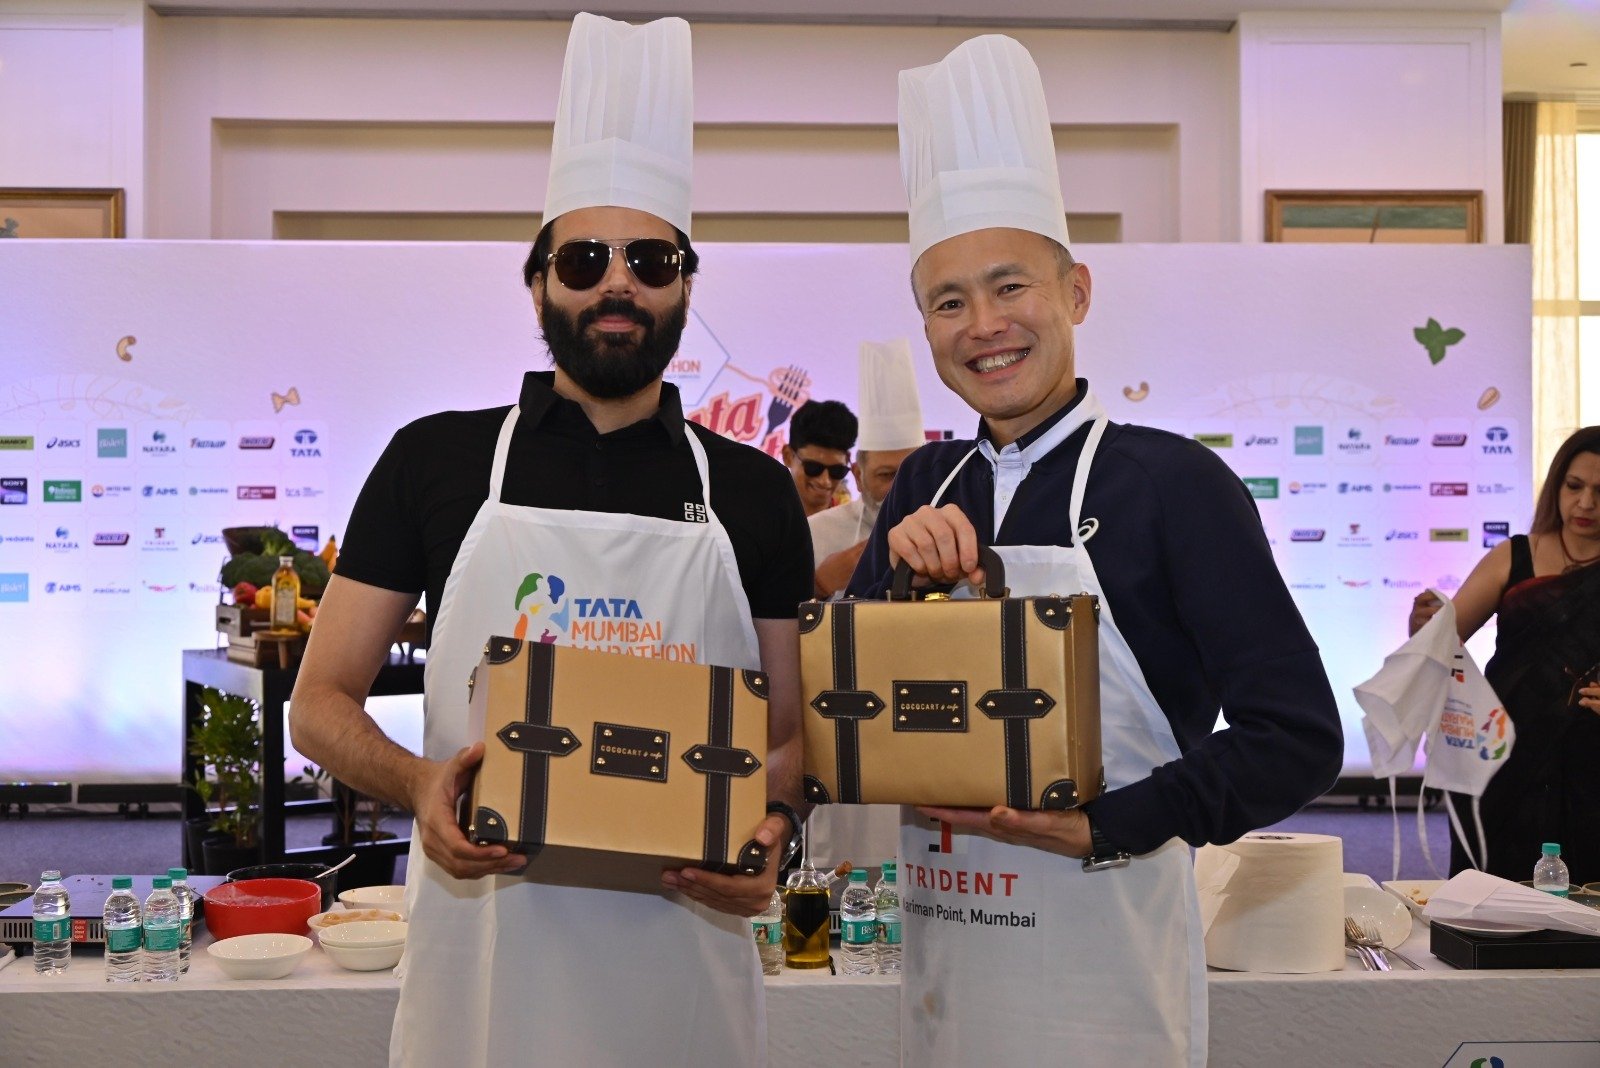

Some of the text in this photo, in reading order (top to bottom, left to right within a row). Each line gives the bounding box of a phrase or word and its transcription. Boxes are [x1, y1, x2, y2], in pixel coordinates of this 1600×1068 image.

[290, 448, 322, 457] TATA
[1481, 445, 1513, 454] TATA
[574, 598, 643, 619] TATA
[571, 620, 663, 642] MUMBAI
[901, 703, 940, 711] COCOCART
[1445, 735, 1475, 749] TATA
[600, 744, 642, 756] COCOCART
[904, 863, 1019, 897] TRIDENT
[936, 904, 967, 926] Point,
[970, 908, 1036, 928] Mumbai
